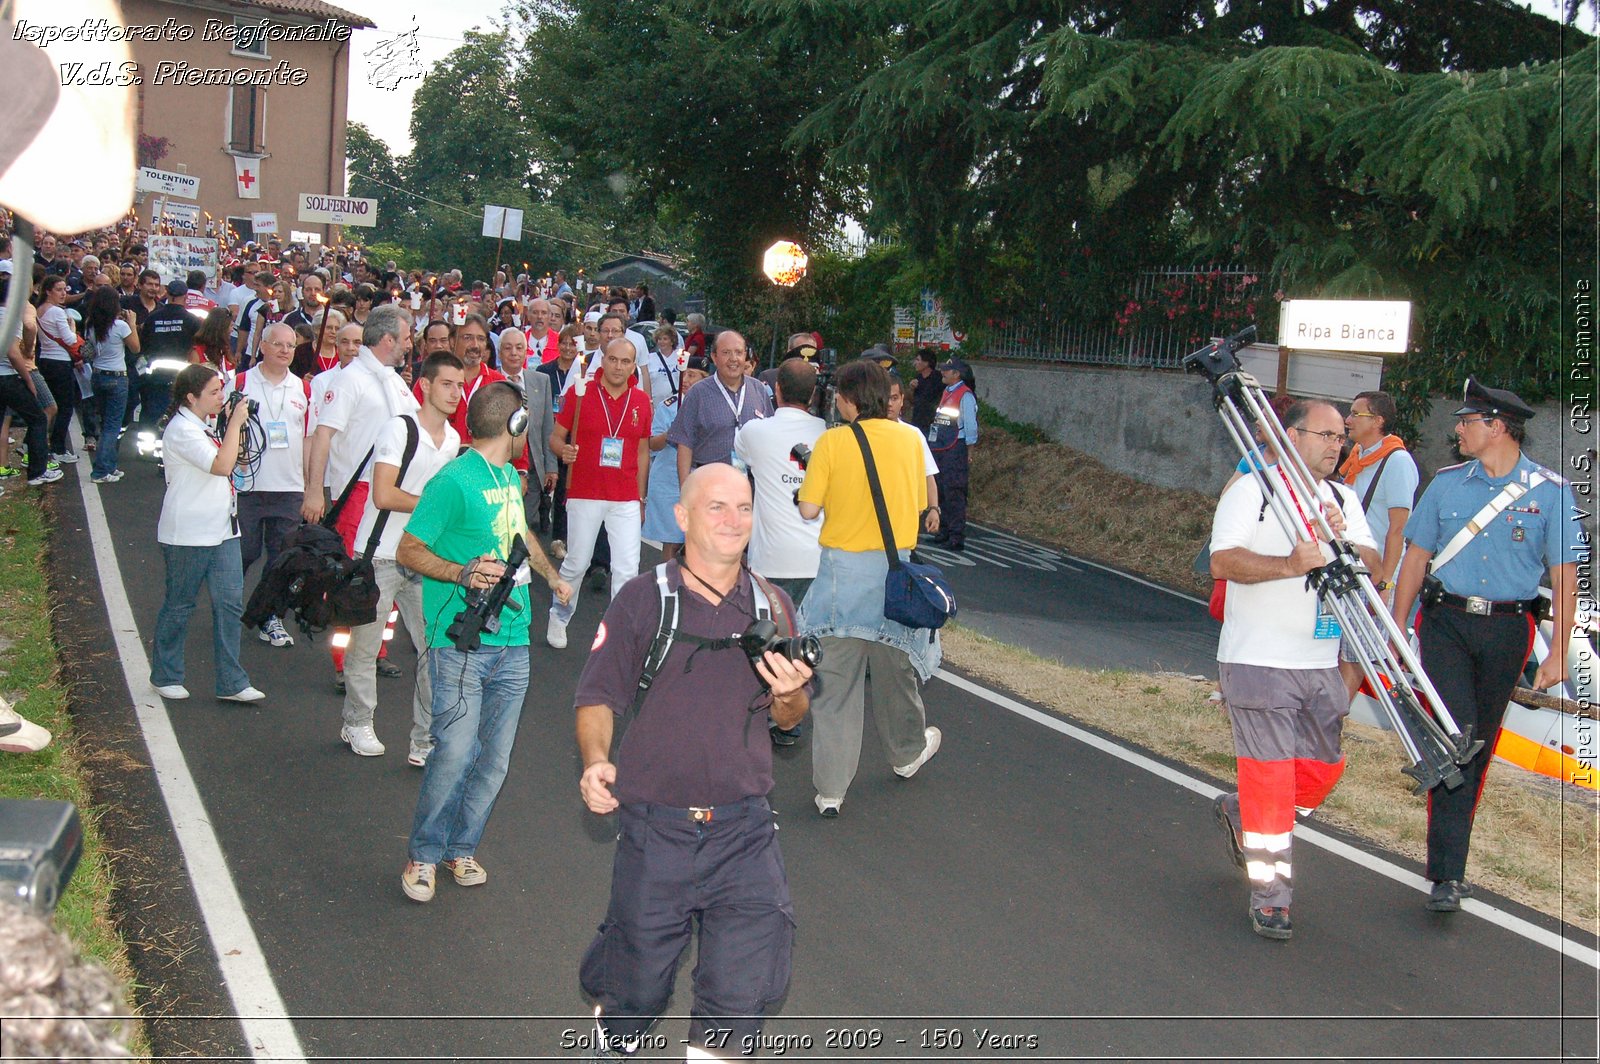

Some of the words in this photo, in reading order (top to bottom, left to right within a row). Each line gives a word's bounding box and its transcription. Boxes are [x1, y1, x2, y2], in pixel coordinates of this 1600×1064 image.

[145, 171, 195, 186] TOLENTINO
[306, 196, 369, 215] SOLFERINO
[152, 216, 198, 230] FANC
[1298, 323, 1331, 340] Ripa
[1341, 324, 1395, 340] Bianca
[781, 474, 803, 484] Creu
